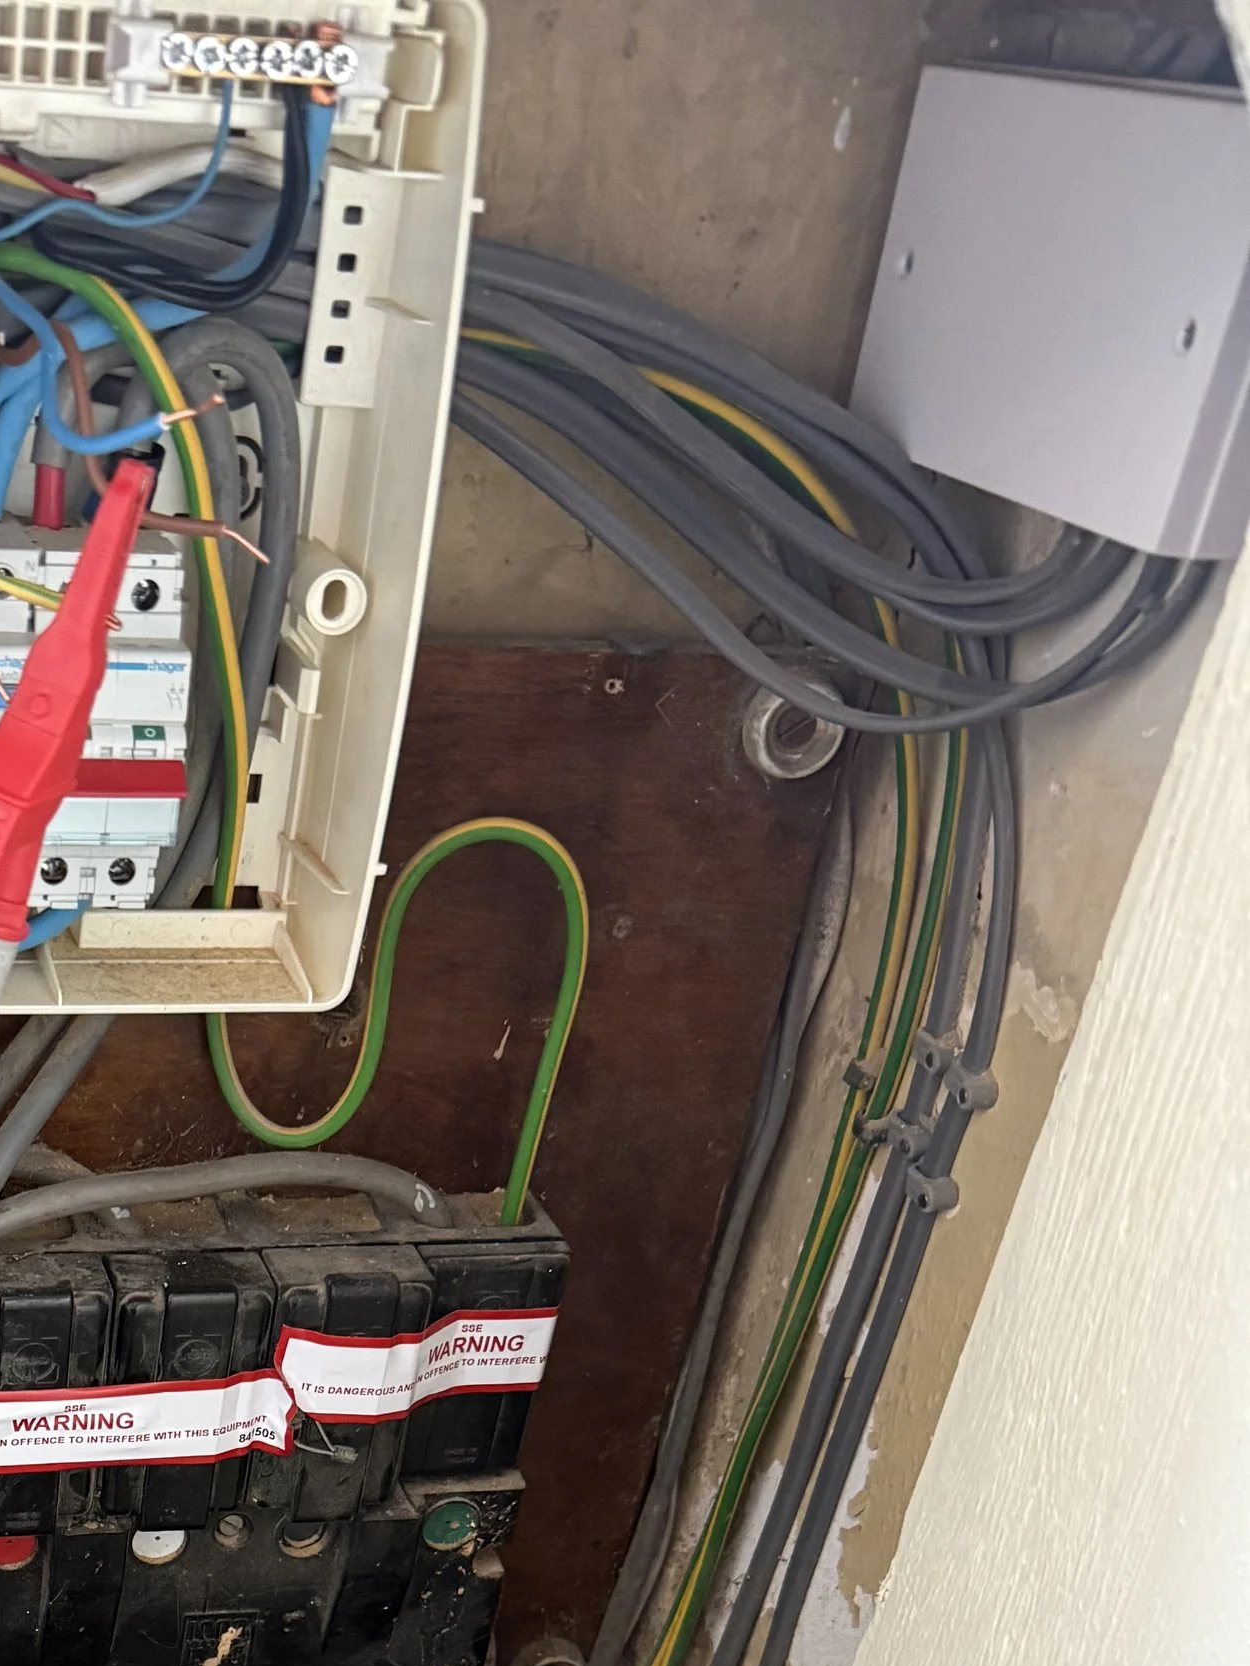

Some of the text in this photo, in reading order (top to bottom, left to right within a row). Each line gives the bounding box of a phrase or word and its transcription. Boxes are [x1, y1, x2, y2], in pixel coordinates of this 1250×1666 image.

[461, 1323, 484, 1334] SSE
[427, 1334, 526, 1366] WARNING
[301, 1381, 312, 1392] IT
[313, 1384, 324, 1394] IS
[327, 1385, 396, 1396] DANGEROUS
[423, 1360, 460, 1381] OFFENCE
[461, 1357, 475, 1367] TO
[477, 1355, 537, 1367] INTERFERE
[64, 1403, 87, 1413] SSE
[11, 1411, 135, 1433] WARNING
[11, 1436, 66, 1447] OFFENCE
[69, 1435, 84, 1444] TO
[86, 1432, 150, 1444] INTERFERE
[153, 1430, 181, 1441] WITH
[184, 1428, 210, 1438] THIS
[212, 1414, 268, 1437] EQUIPMENT
